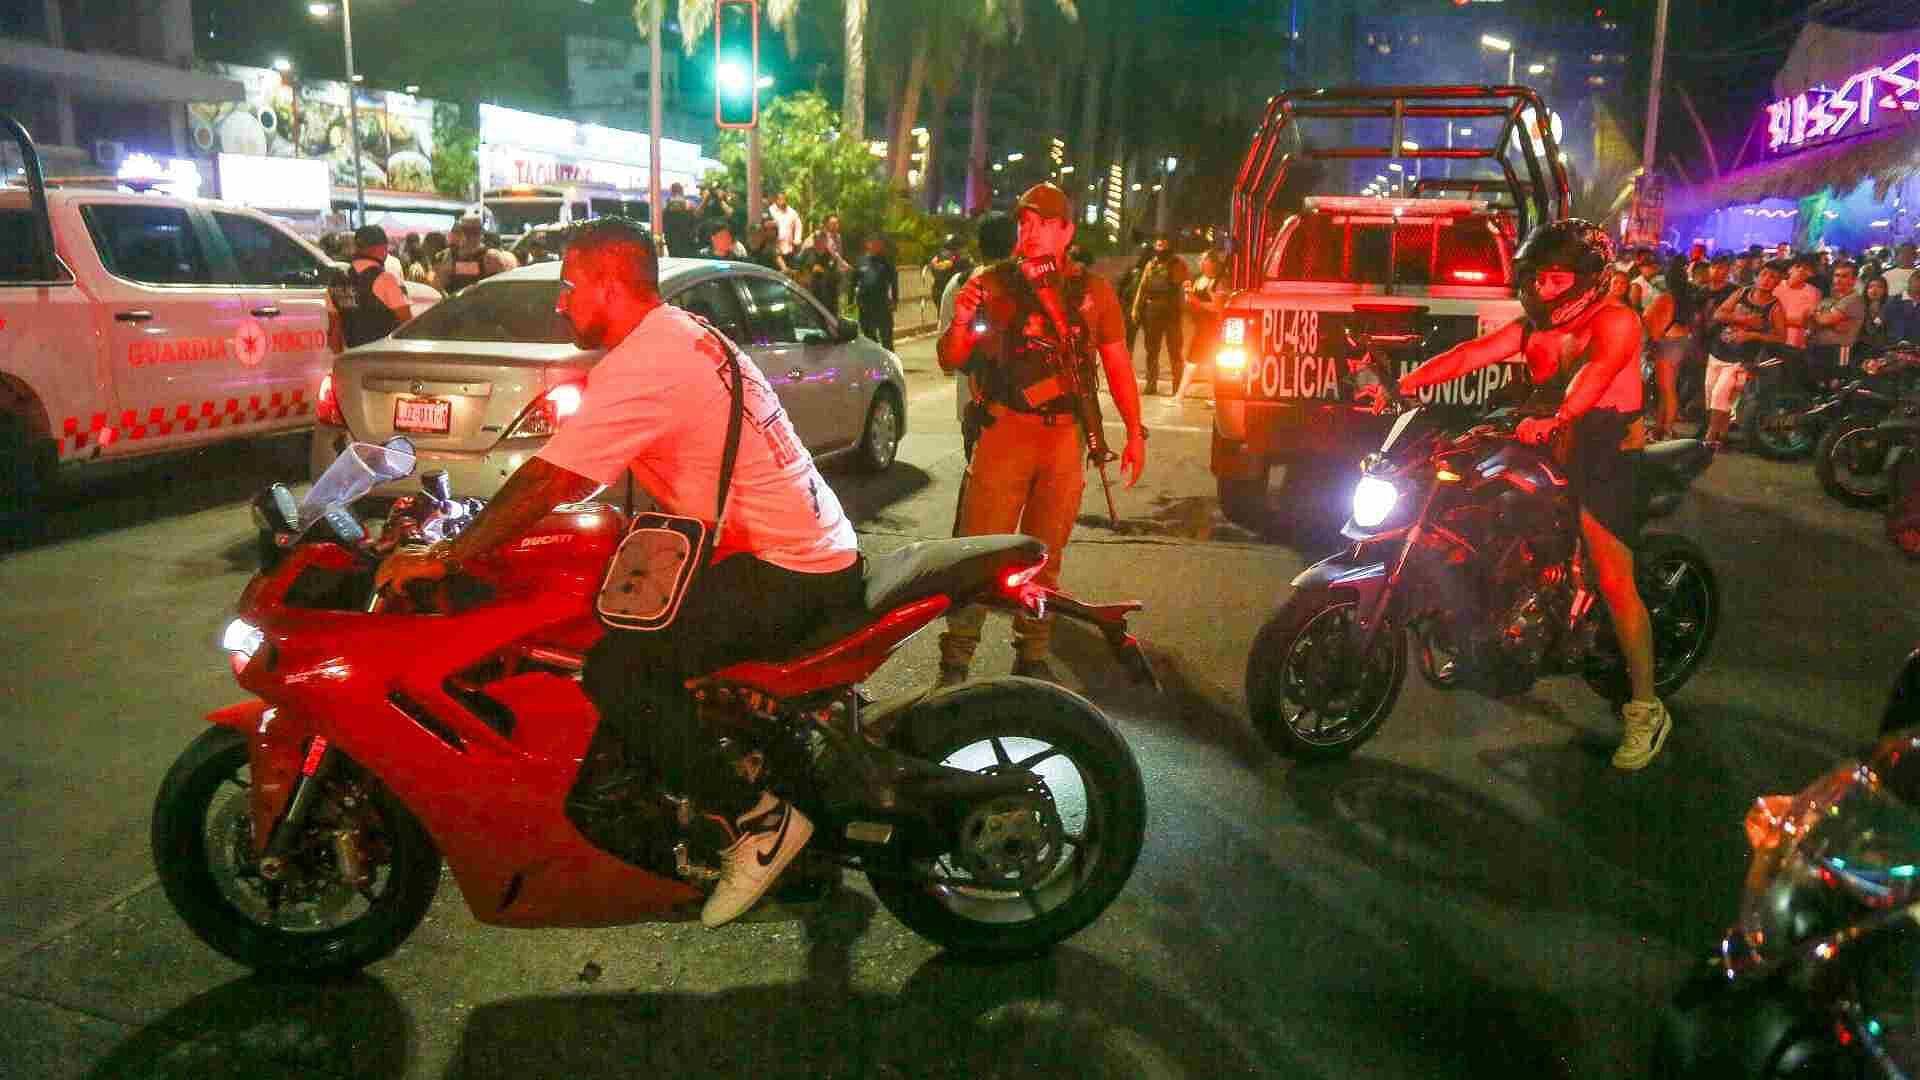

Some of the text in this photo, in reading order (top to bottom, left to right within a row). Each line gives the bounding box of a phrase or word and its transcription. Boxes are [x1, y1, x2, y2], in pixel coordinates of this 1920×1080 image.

[1262, 308, 1319, 353] PU-438
[1246, 354, 1522, 406] POLICIA UNICIPA
[521, 534, 575, 546] DUCATI
